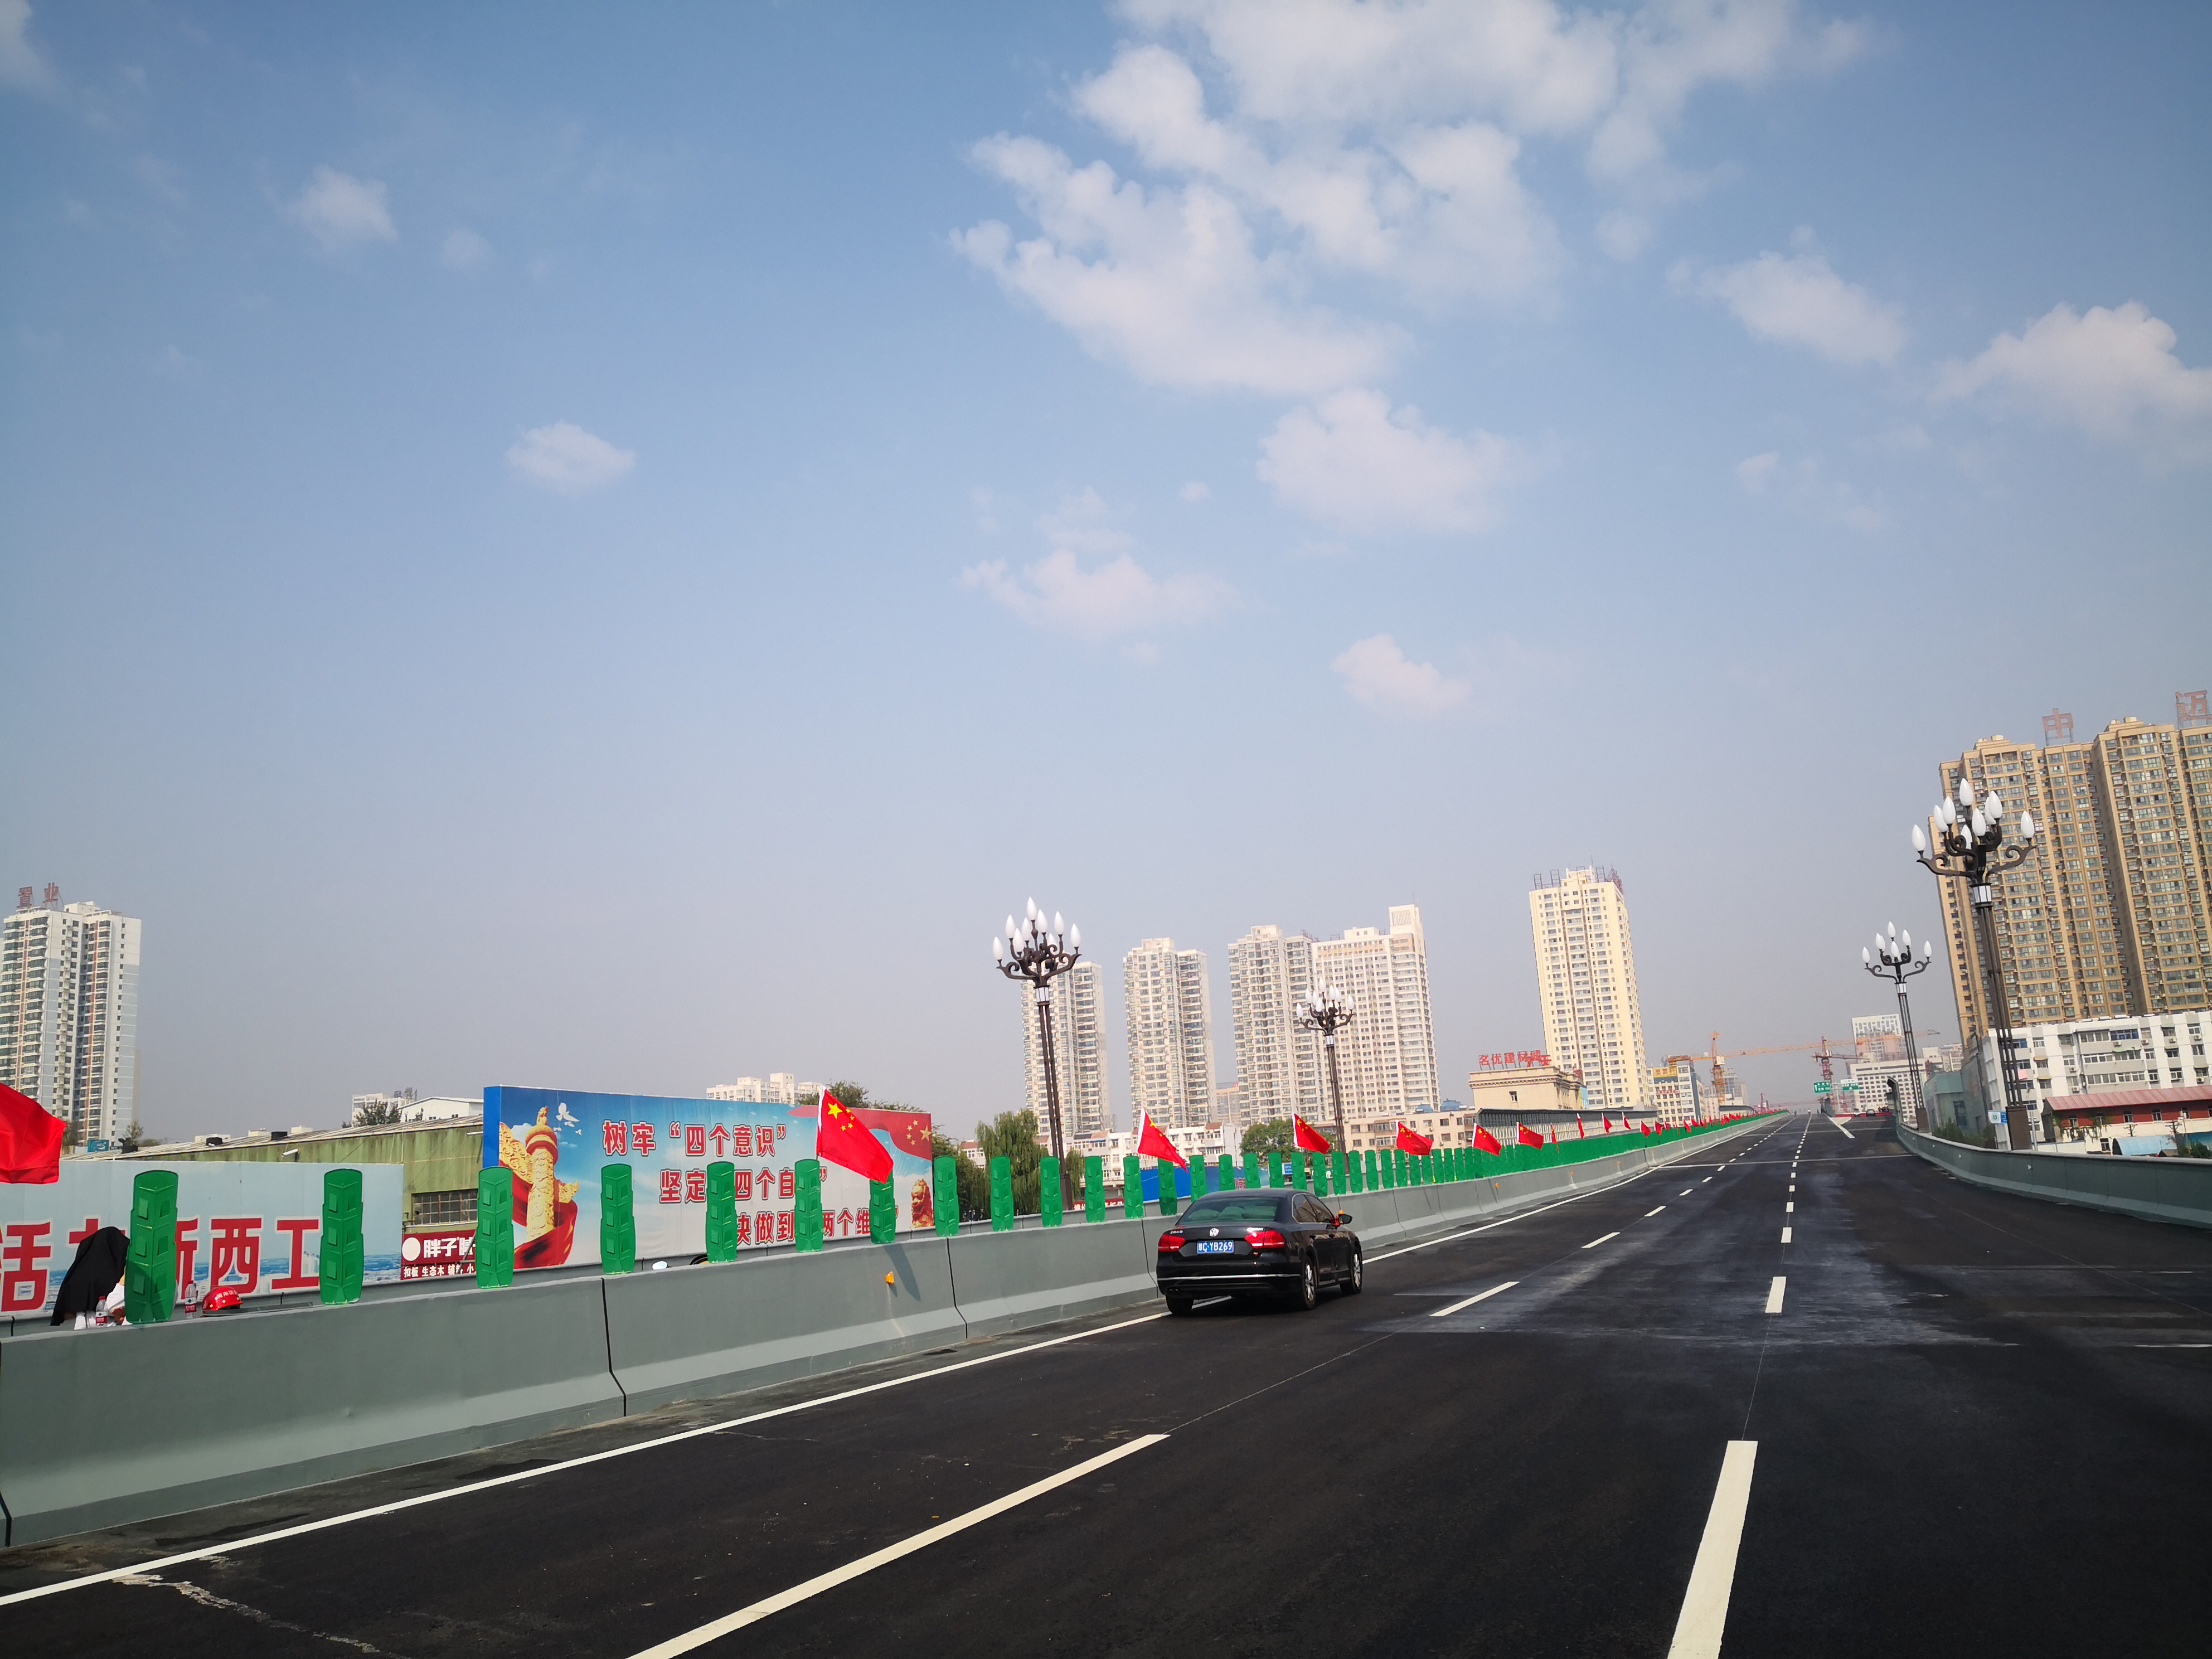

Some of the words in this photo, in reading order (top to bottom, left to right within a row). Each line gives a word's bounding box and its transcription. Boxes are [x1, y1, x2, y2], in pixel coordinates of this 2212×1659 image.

[2042, 708, 2074, 739] 中
[17, 882, 59, 908] 置业
[404, 1267, 418, 1278] 扣板
[421, 1265, 444, 1277] 生态木
